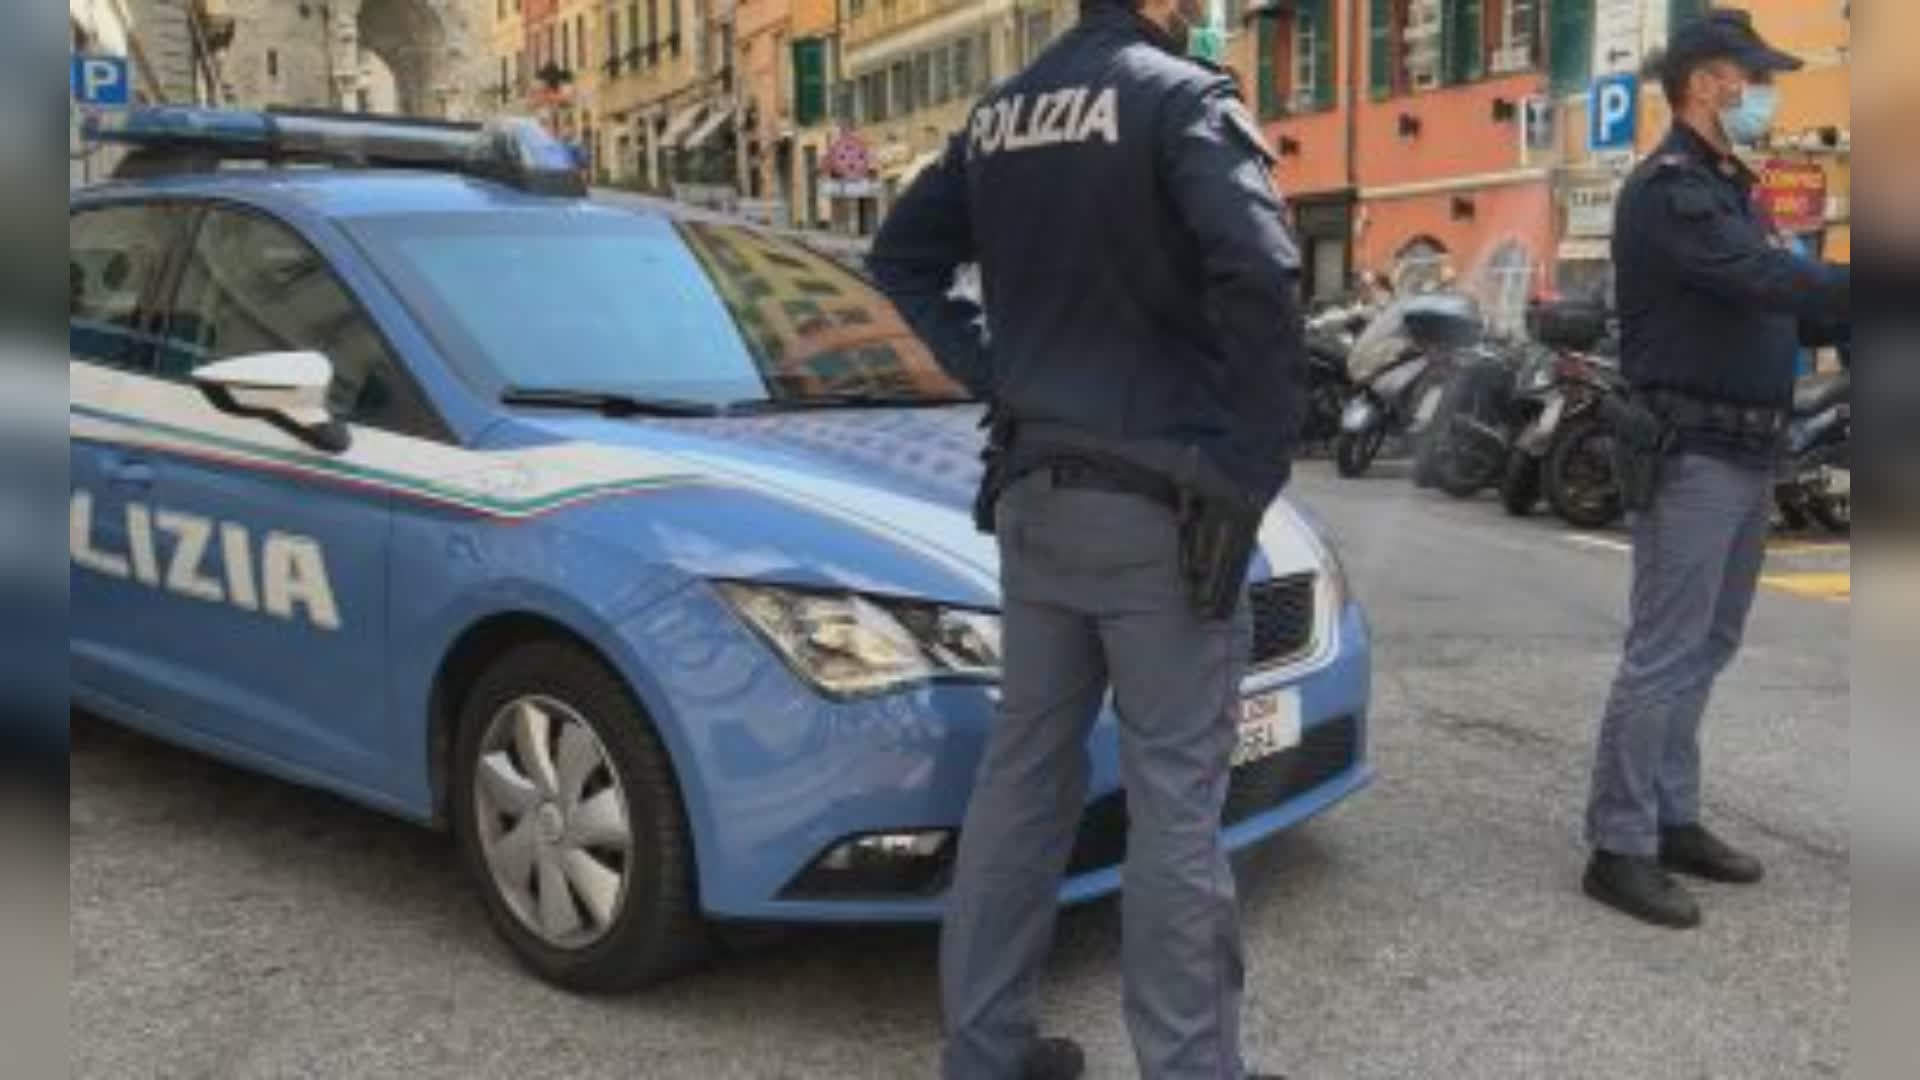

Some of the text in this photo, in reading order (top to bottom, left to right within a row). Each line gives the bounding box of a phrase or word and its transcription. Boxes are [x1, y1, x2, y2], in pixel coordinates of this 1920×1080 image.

[84, 61, 118, 99] P
[967, 87, 1119, 159] POLIZIA
[1600, 83, 1630, 142] P
